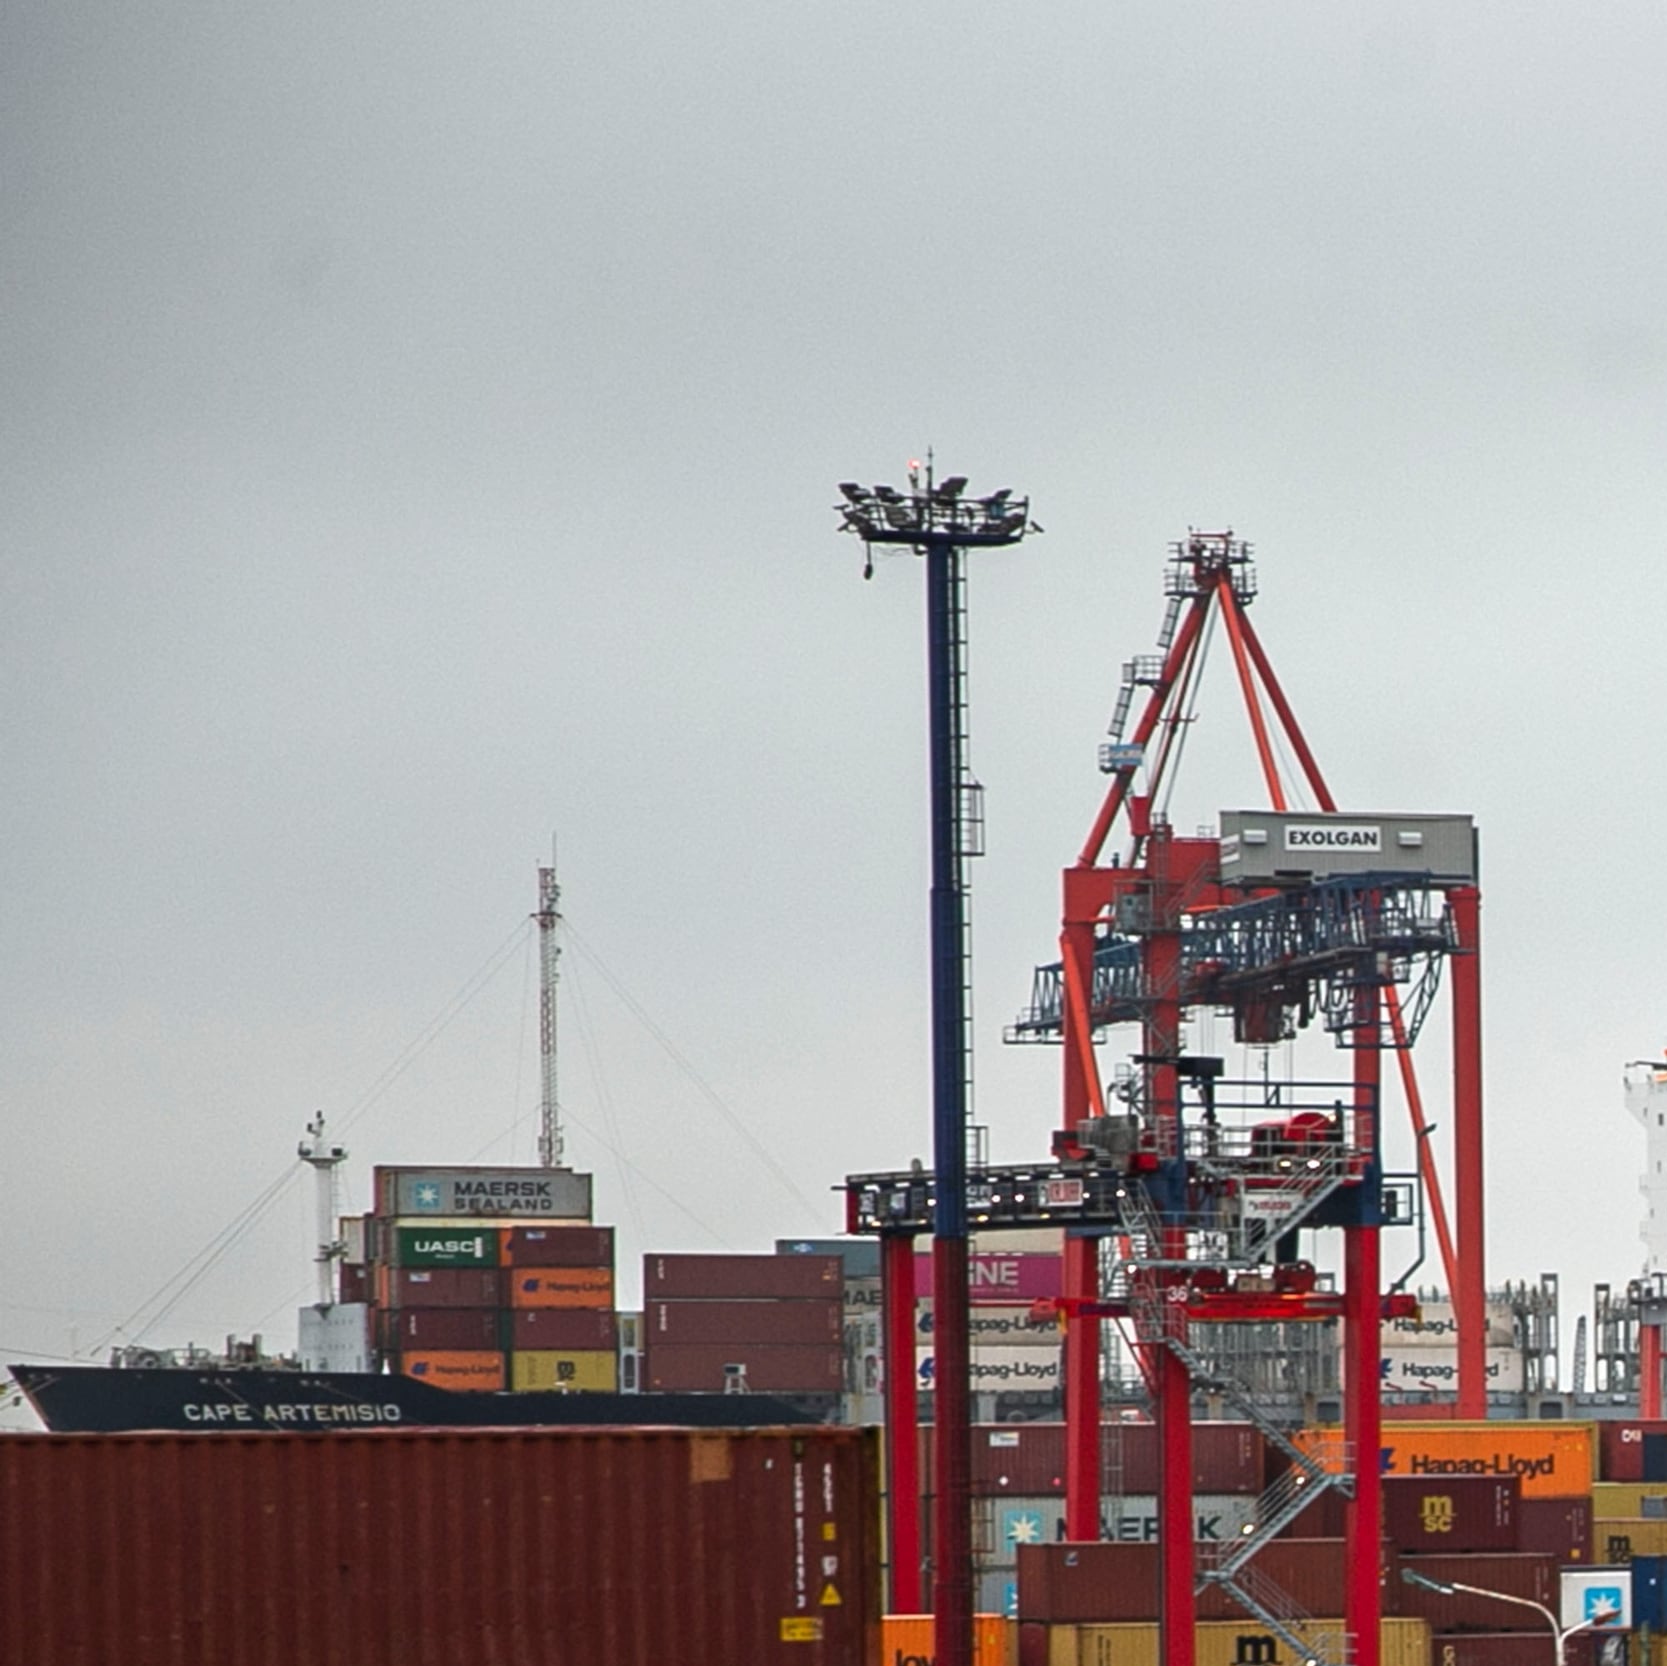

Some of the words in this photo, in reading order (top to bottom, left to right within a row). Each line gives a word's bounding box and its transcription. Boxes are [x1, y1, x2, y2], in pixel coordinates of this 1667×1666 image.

[1289, 832, 1378, 846] EXOLGAN
[454, 1181, 550, 1196] MAERSK
[455, 1198, 552, 1210] SEALAND
[415, 1240, 473, 1252] UASC
[968, 1312, 1056, 1334] apag-Lloyd
[968, 1361, 1057, 1378] apag-Lloyd
[183, 1403, 251, 1422] CAPE
[264, 1403, 400, 1422] ARTEMISIO
